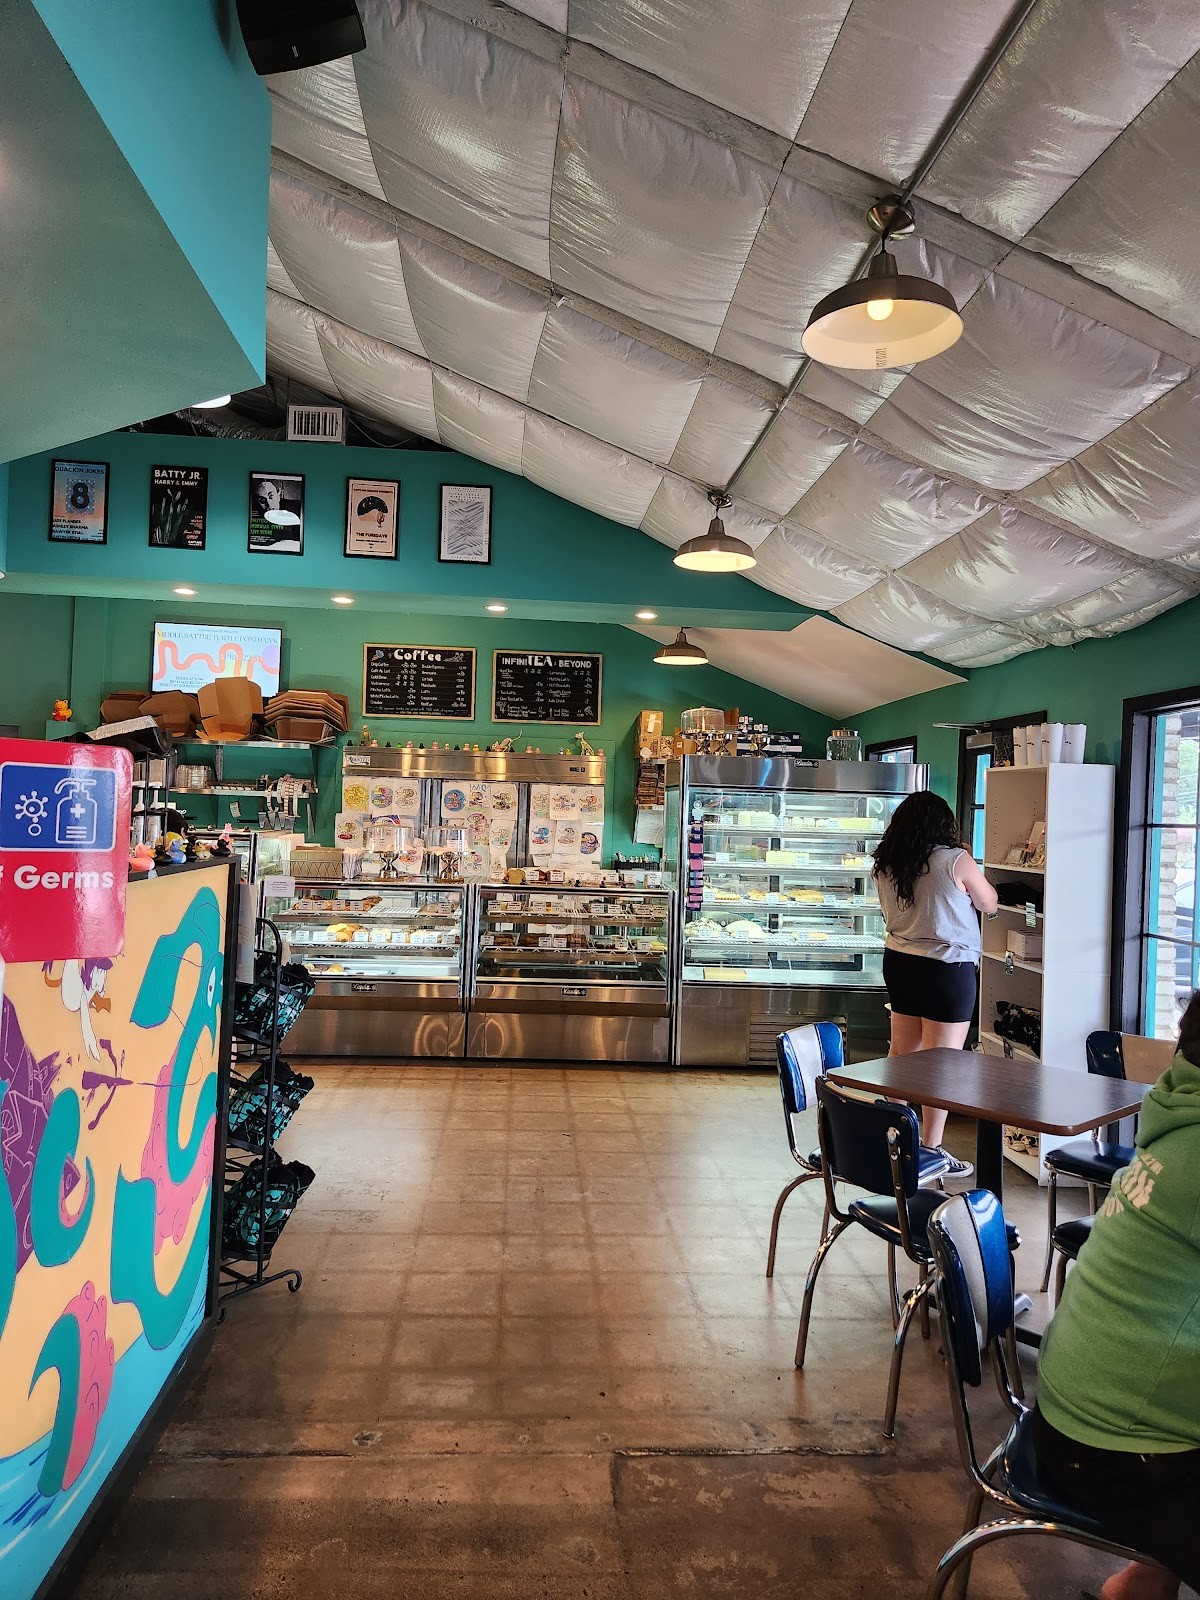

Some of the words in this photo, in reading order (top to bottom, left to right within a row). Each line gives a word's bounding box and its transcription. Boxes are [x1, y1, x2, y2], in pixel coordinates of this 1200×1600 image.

[155, 470, 186, 478] BATTY
[71, 483, 90, 509] 8
[394, 649, 441, 661] Coffee
[558, 660, 592, 668] BEYOND
[14, 865, 114, 889] Germs
